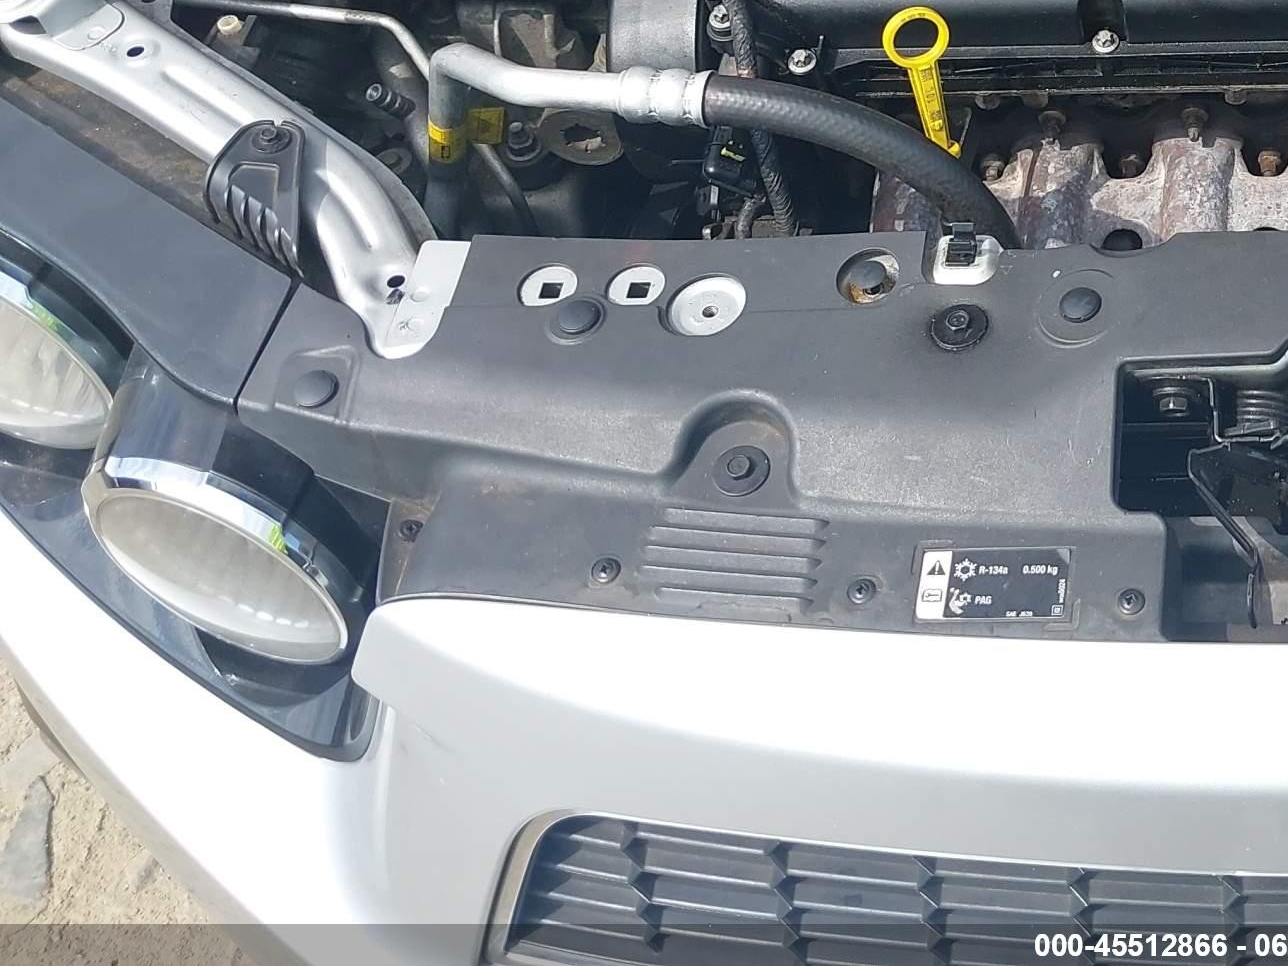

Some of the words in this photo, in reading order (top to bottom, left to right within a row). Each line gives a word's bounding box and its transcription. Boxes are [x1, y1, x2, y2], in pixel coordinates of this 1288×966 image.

[978, 565, 1009, 575] R-134a
[1022, 565, 1046, 575] 0.500
[1047, 565, 1059, 576] kg
[974, 595, 993, 605] PAG
